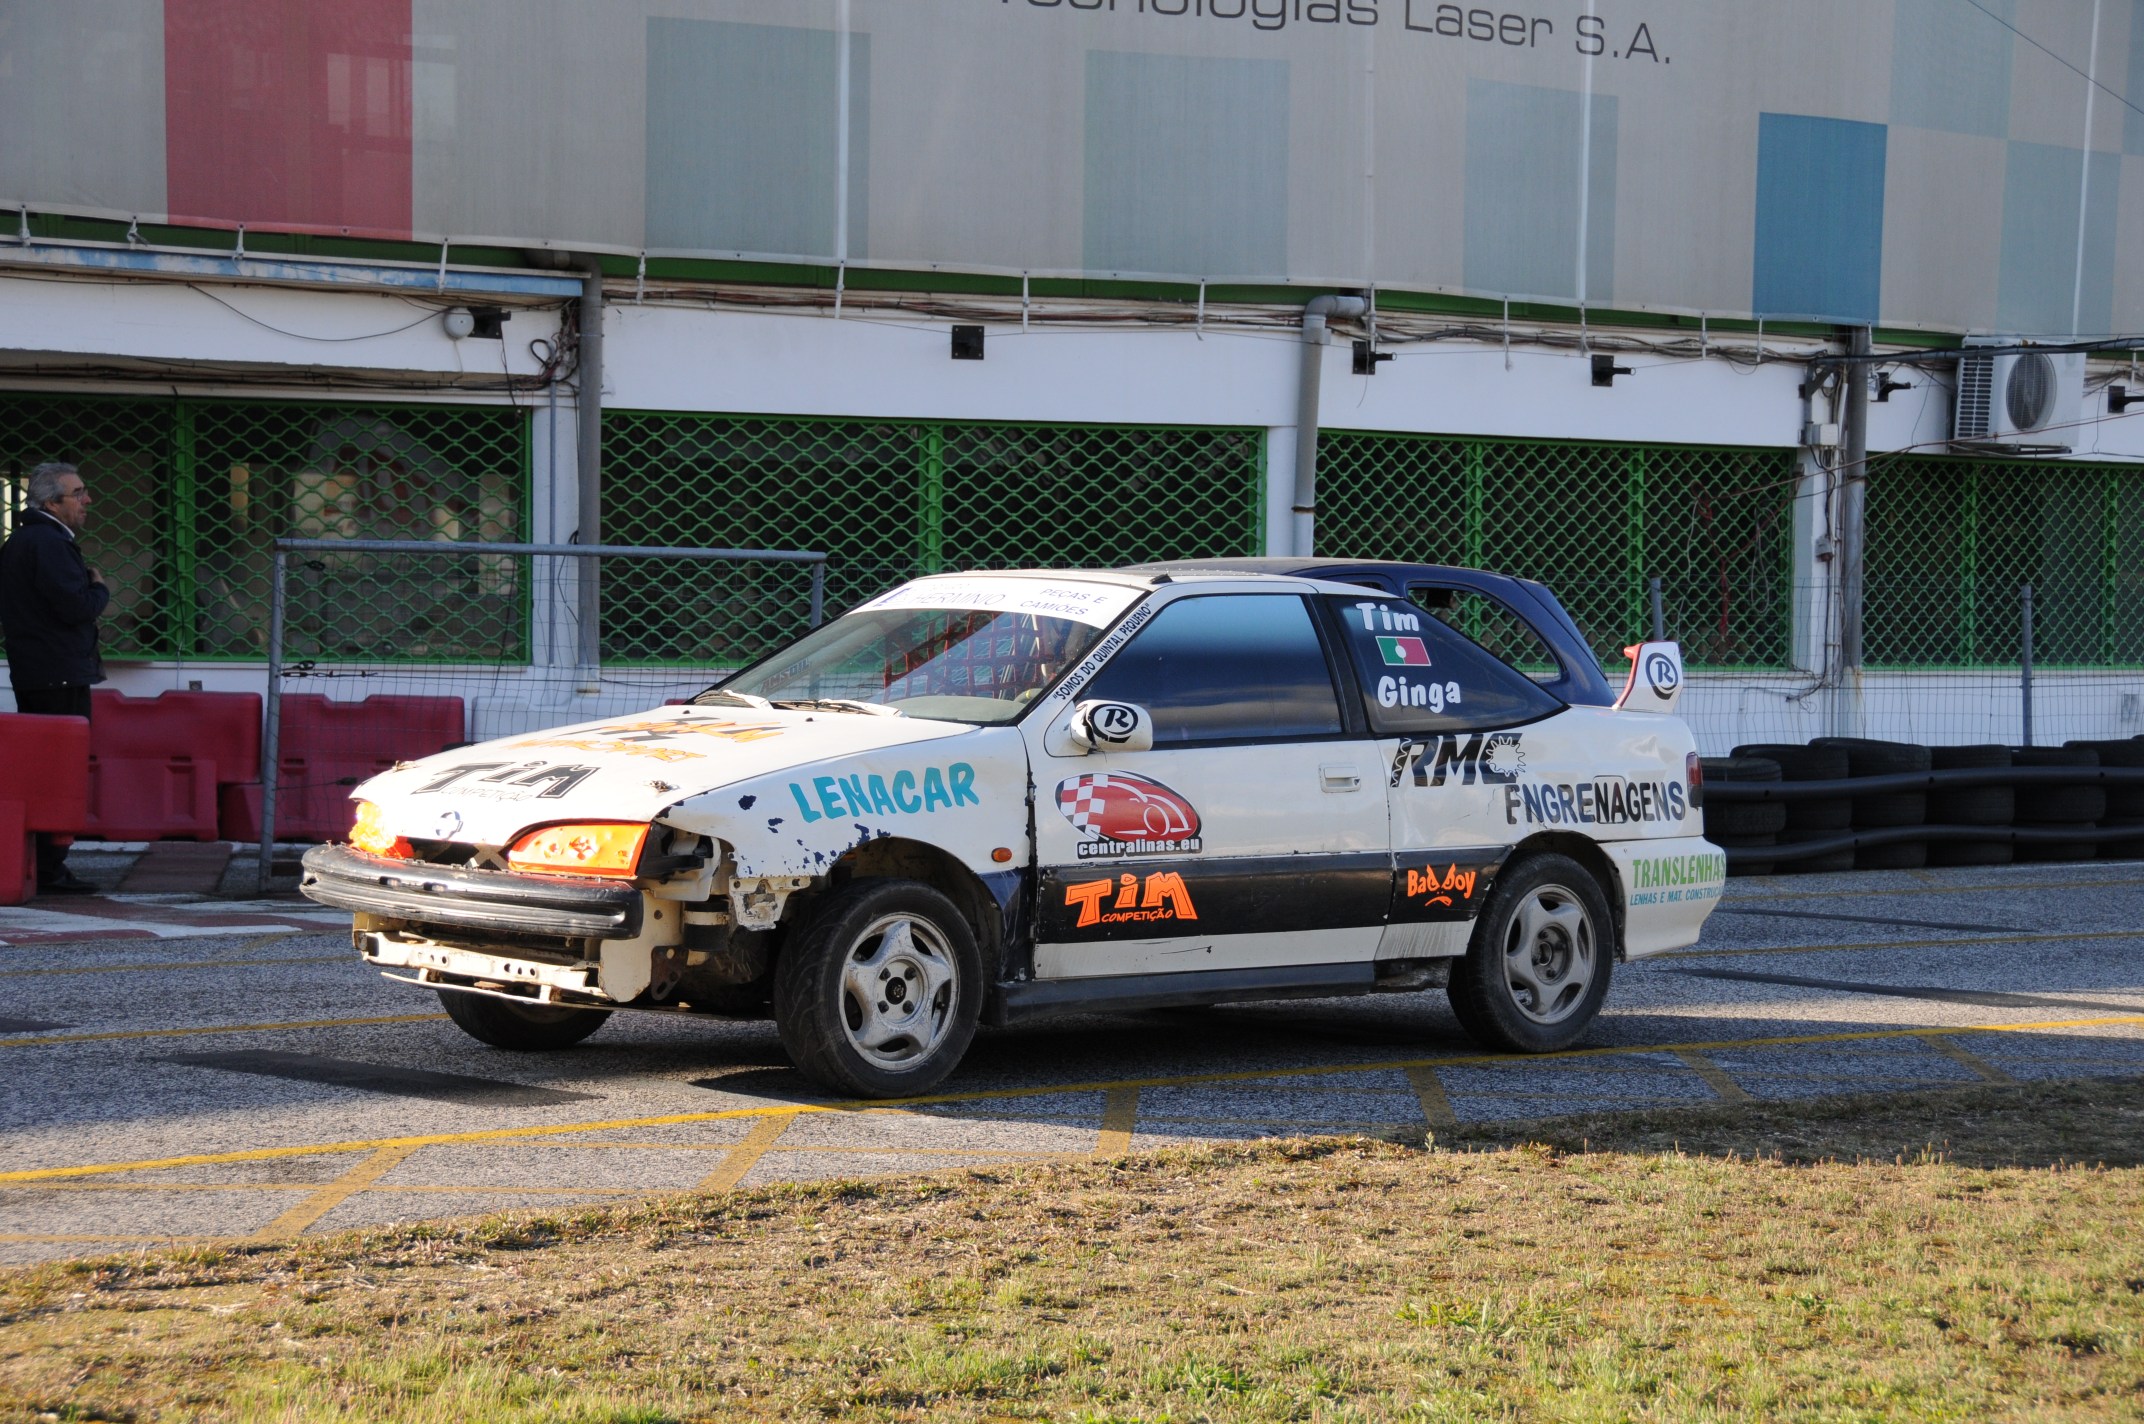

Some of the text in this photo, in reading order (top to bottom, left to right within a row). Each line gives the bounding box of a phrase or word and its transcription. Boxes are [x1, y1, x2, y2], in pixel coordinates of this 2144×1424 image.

[1405, 1, 1553, 48] Laser
[1575, 14, 1672, 64] S.A.
[1093, 596, 1109, 606] E
[1356, 602, 1419, 632] Tim
[1080, 661, 1096, 676] DO
[1093, 634, 1124, 662] QUINTAL
[1377, 675, 1461, 714] Ginga
[1104, 707, 1130, 730] R
[788, 762, 980, 824] LENACAR
[1078, 838, 1200, 855] centralinas.eu
[1632, 853, 1726, 888] TRANSLENHAS
[1629, 892, 1658, 906] LENHAS
[1659, 891, 1666, 904] E
[1101, 907, 1174, 922] COMPETIÇÃO
